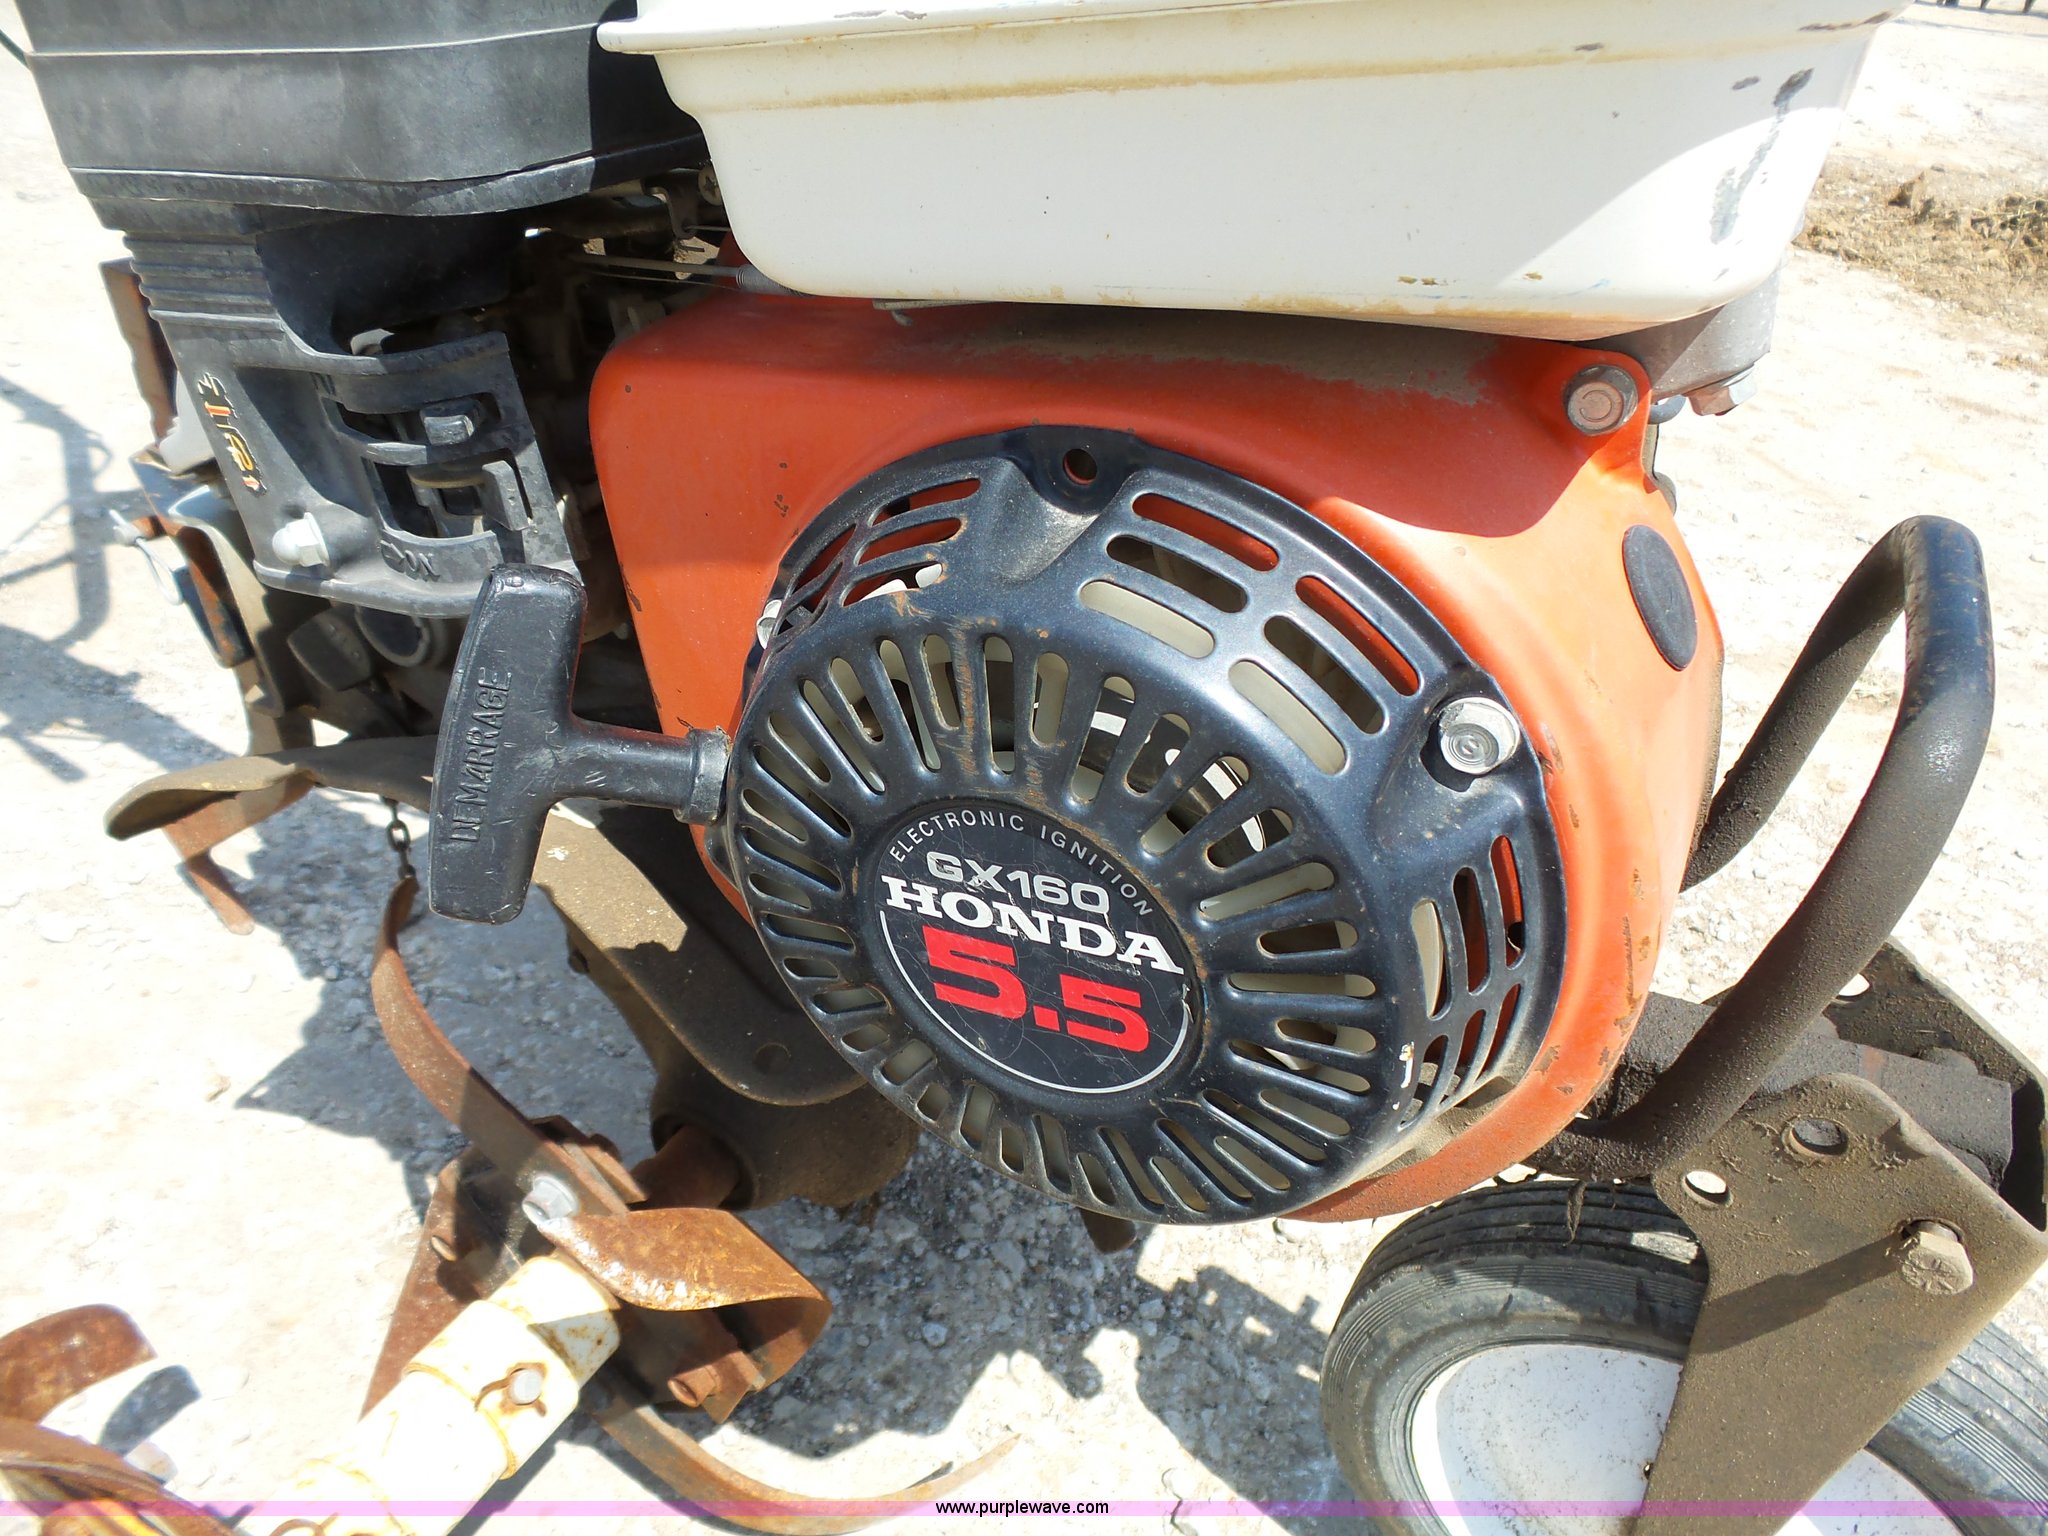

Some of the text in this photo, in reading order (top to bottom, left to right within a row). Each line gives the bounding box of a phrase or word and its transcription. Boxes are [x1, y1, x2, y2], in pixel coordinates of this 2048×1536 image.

[889, 809, 1153, 916] ELECTRONIC IGNITION
[926, 850, 1110, 914] GX160
[881, 875, 1185, 975] HONDA
[922, 925, 1150, 1053] 5.5
